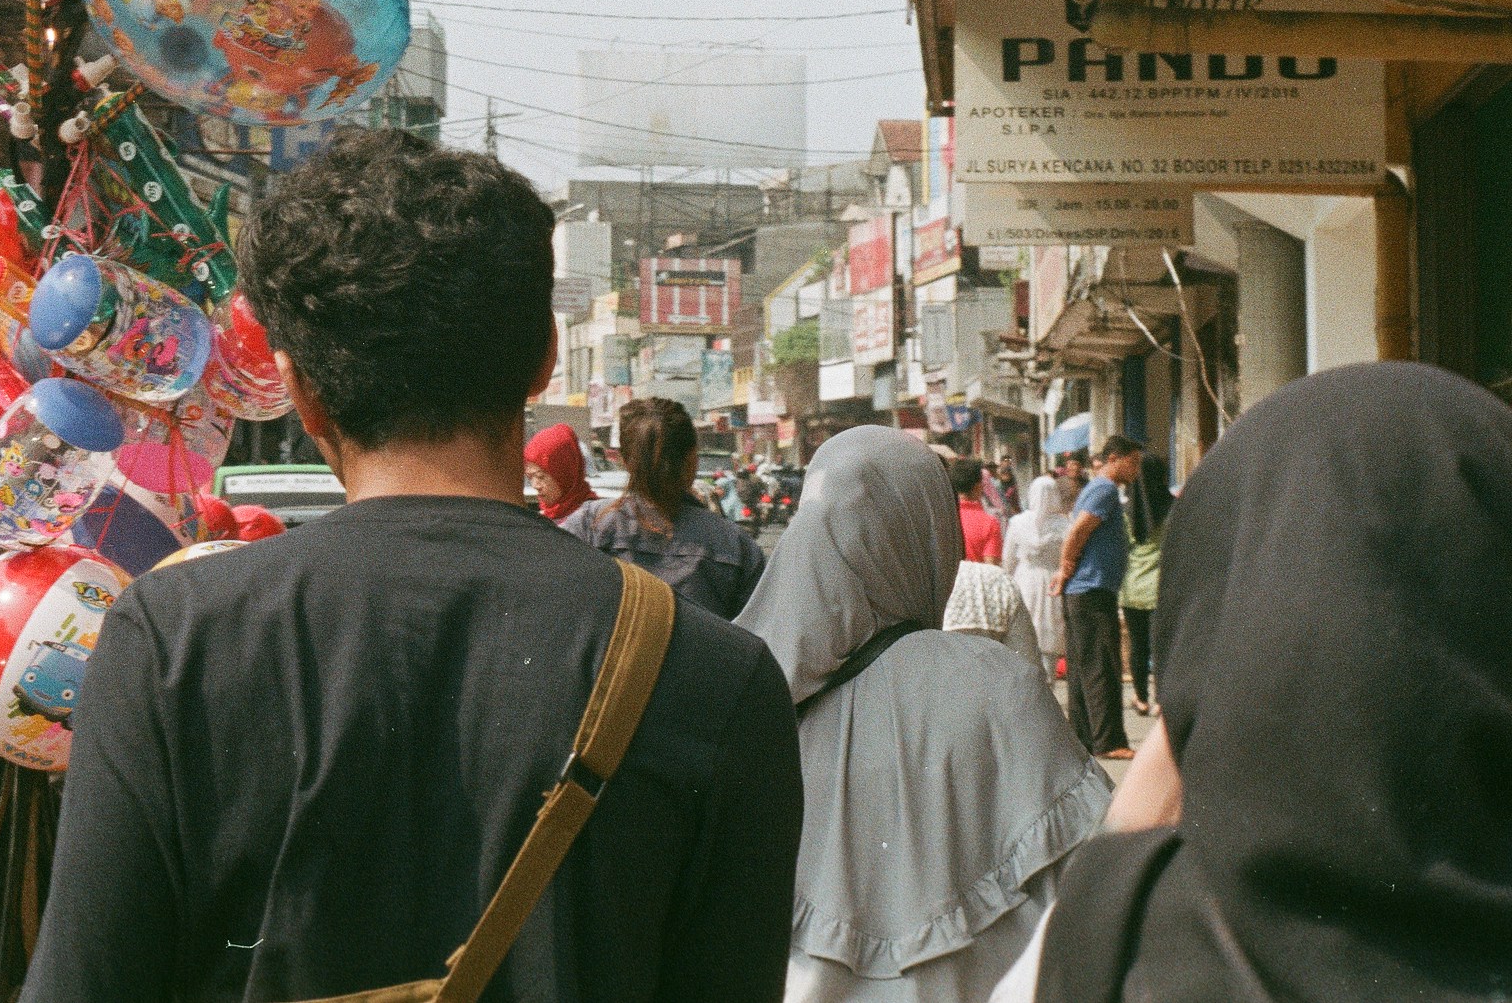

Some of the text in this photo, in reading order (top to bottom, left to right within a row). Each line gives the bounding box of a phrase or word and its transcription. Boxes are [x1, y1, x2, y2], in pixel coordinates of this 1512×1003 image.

[1043, 87, 1071, 100] SIA
[969, 106, 1066, 119] APOTEKER
[1042, 159, 1115, 174] KENCANA
[1151, 159, 1168, 173] 32
[1173, 159, 1229, 174] BOGOR
